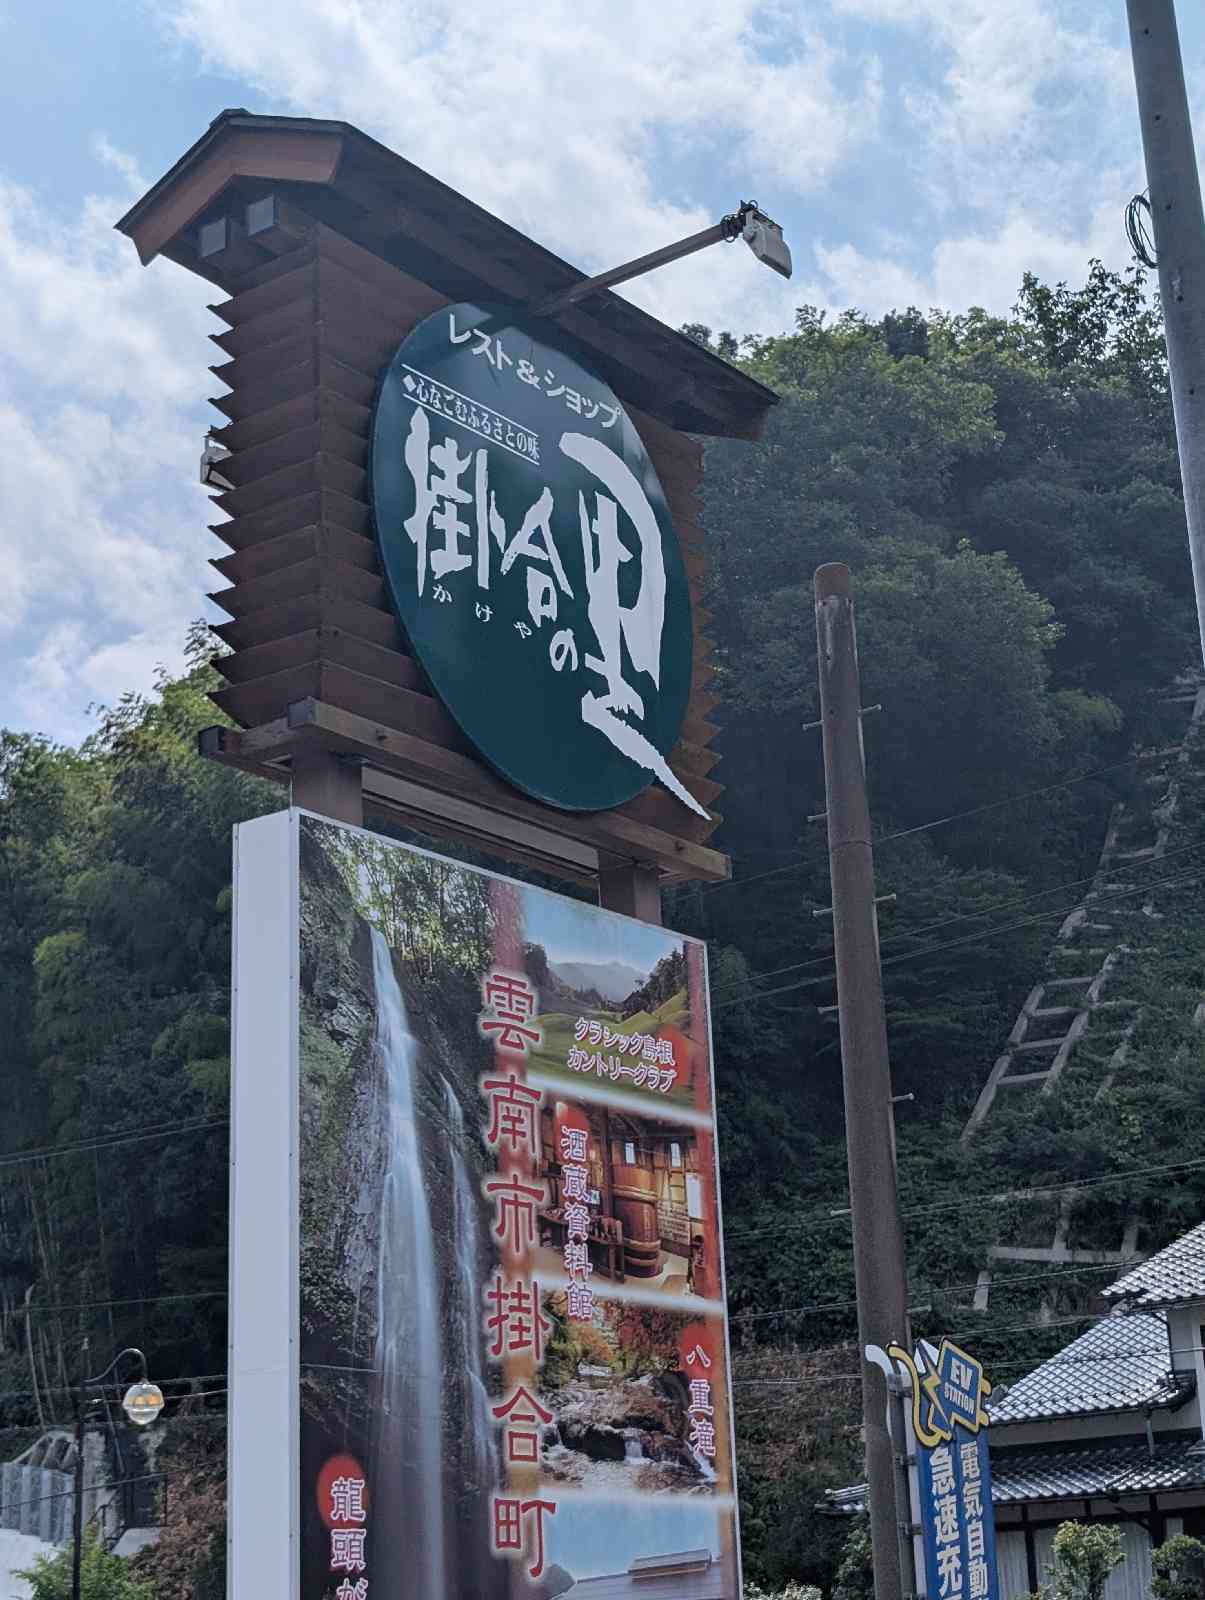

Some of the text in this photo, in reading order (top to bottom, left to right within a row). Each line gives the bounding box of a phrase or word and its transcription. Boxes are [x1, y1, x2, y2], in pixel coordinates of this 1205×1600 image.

[416, 378, 540, 460] 心なごむふるさとの味
[404, 406, 712, 821] 掛合の里
[567, 1044, 677, 1093] カントリークラブ
[574, 1016, 676, 1066] クラシック島根
[482, 974, 556, 1578] 雲南市掛合町
[560, 1126, 593, 1321] 酒蔵資料館
[944, 1381, 975, 1415] STATION
[950, 1356, 973, 1391] EV
[929, 1447, 964, 1600] 急速充
[960, 1441, 989, 1600] 電気自動
